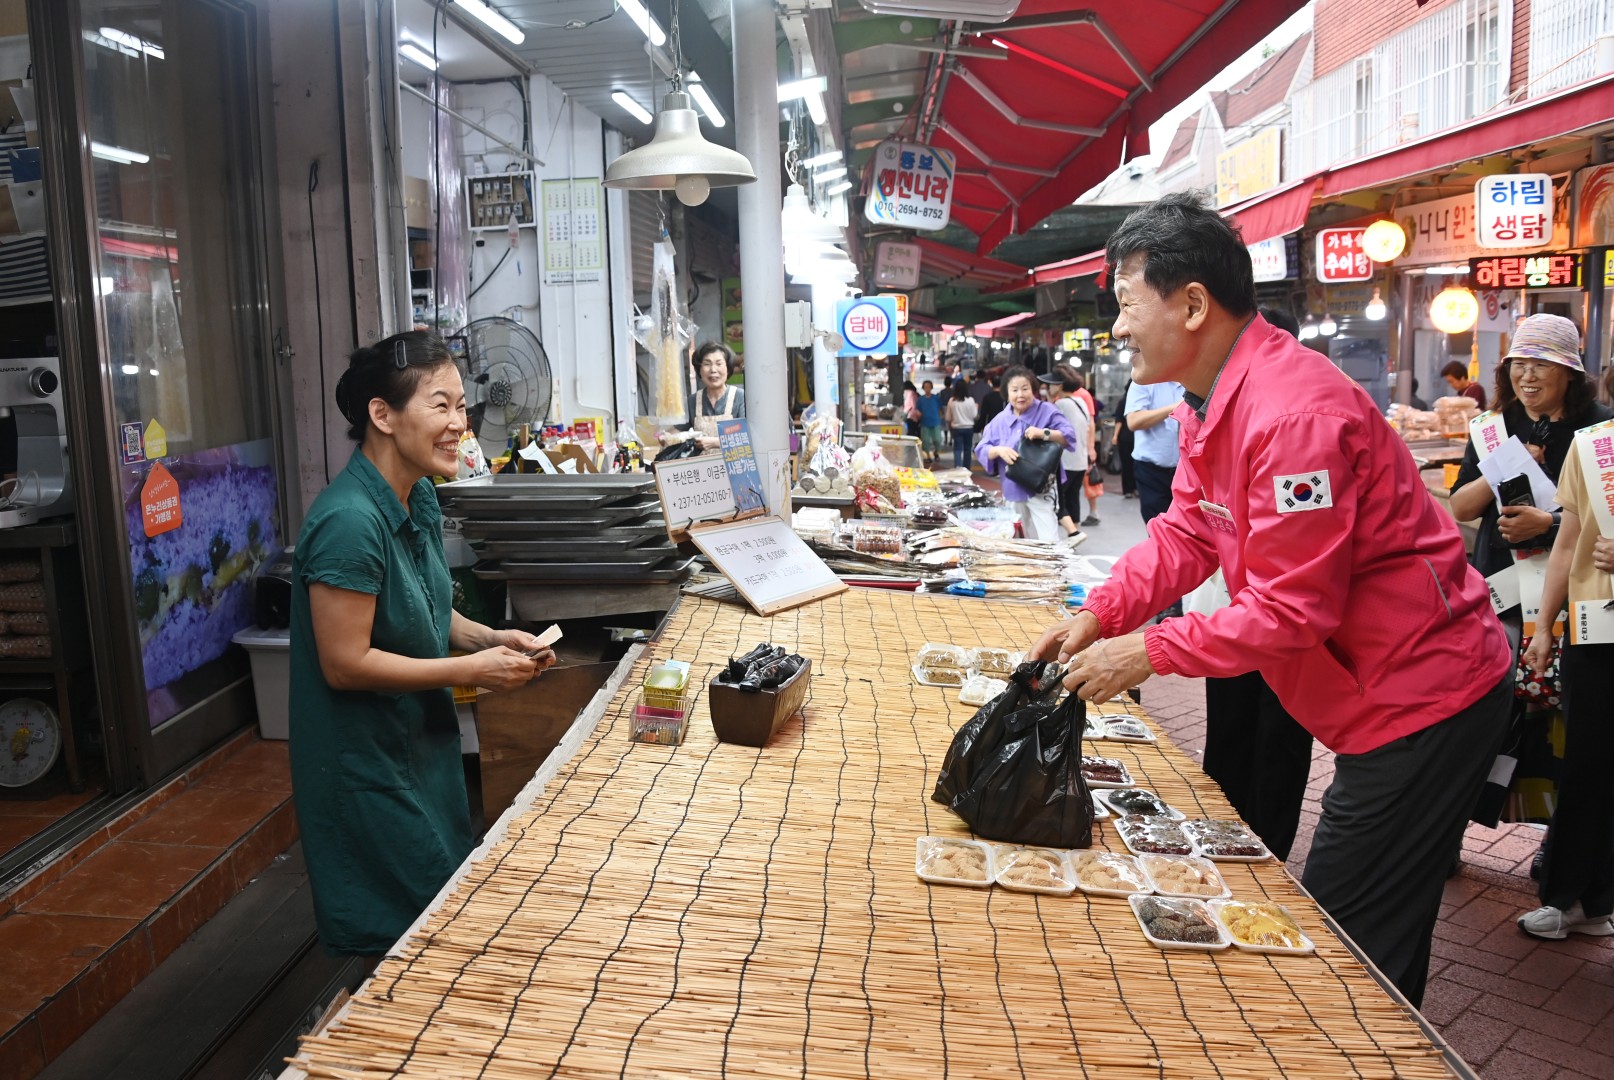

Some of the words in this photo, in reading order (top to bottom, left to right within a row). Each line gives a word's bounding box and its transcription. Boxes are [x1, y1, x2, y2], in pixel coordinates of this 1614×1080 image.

[881, 168, 949, 205] 생선나라
[1491, 179, 1545, 206] 하림
[1492, 213, 1547, 240] 생닭
[1325, 251, 1369, 277] 추어탕
[1476, 255, 1574, 287] 하림생닭
[849, 316, 884, 333] 담배
[719, 431, 750, 449] 민생회복
[724, 444, 753, 462] 소비쿠폰
[672, 468, 701, 487] 부산은행
[706, 464, 727, 480] 이금주
[145, 495, 178, 516] 온누리상품권
[154, 509, 172, 524] 가맹점
[1206, 514, 1234, 534] 김성수
[753, 554, 767, 564] 3팩
[1490, 587, 1505, 609] 해운대구
[1580, 613, 1588, 641] 해운대구
